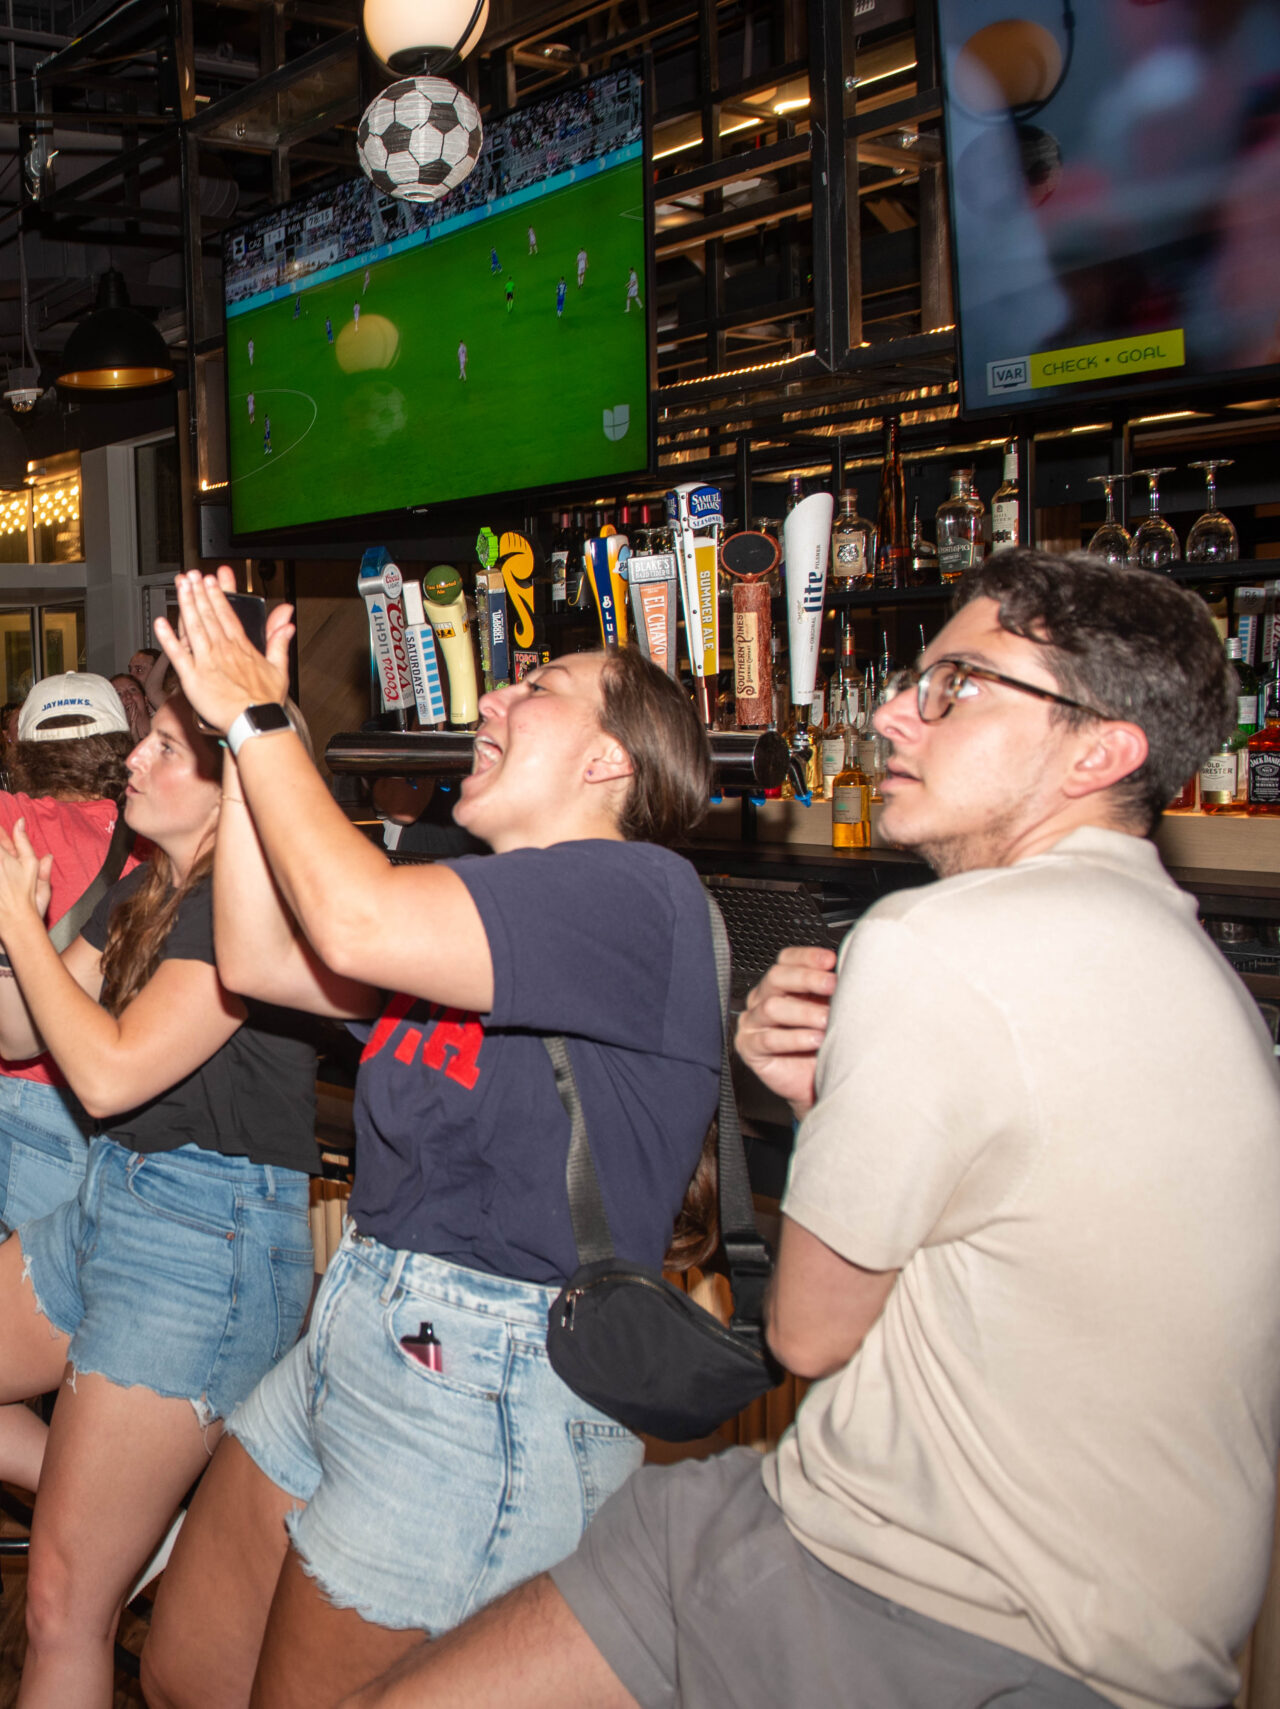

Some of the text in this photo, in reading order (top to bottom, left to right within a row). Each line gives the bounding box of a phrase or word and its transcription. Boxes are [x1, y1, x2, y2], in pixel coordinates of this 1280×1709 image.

[996, 367, 1023, 381] VAR
[1042, 345, 1167, 376] CHECK GOAL
[692, 492, 721, 505] SAMUEL
[695, 501, 720, 513] ADAMS
[634, 558, 670, 572] BLAKE'S
[643, 595, 665, 612] EL
[803, 571, 824, 613] lite
[602, 595, 614, 644] BLUE
[699, 570, 715, 651] SUMMER ALE
[647, 613, 668, 655] CHAVO
[374, 615, 400, 702] Coors LIGHT
[406, 637, 424, 695] SATURDAYS
[515, 653, 537, 663] TORCH
[735, 614, 757, 696] SOUTHERN PINES
[41, 698, 91, 711] JAYHAWKS
